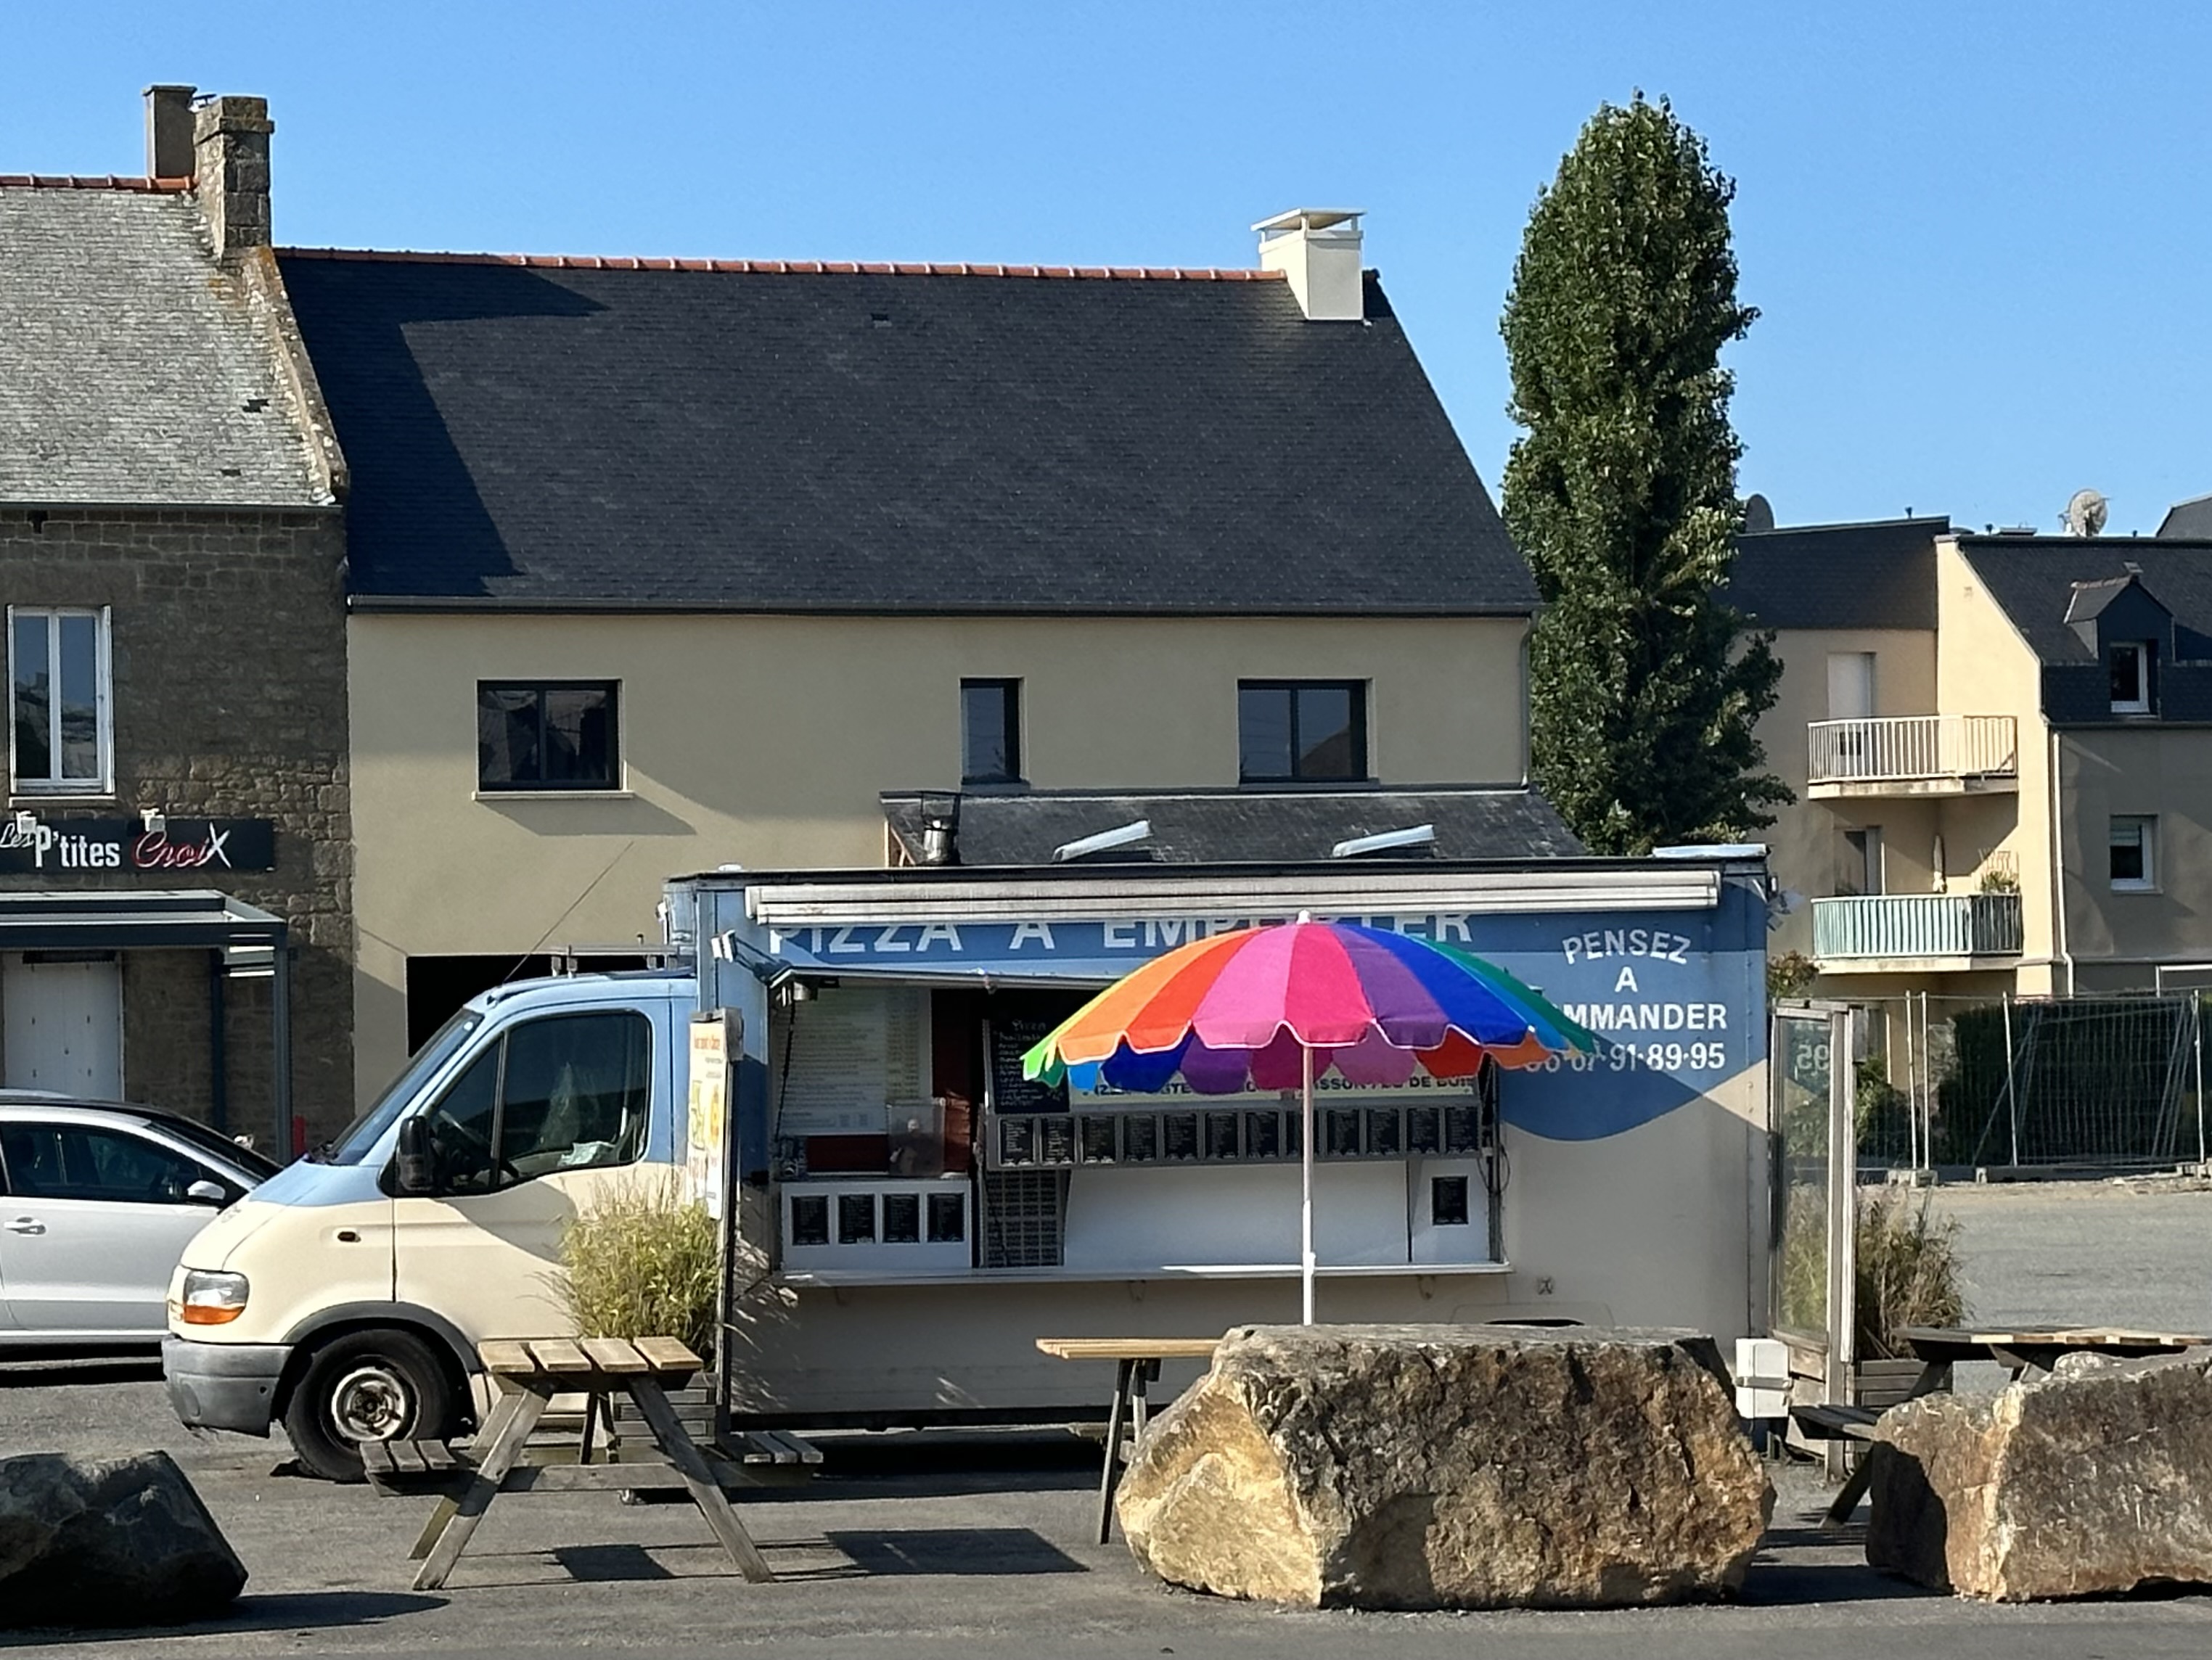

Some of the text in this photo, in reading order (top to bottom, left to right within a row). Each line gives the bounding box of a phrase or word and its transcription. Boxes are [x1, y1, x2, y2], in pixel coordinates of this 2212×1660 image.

[36, 824, 120, 868] P'tites
[1562, 929, 1692, 965] PENSEZ
[1614, 966, 1638, 993] A
[1562, 1003, 1727, 1030] MMANDER
